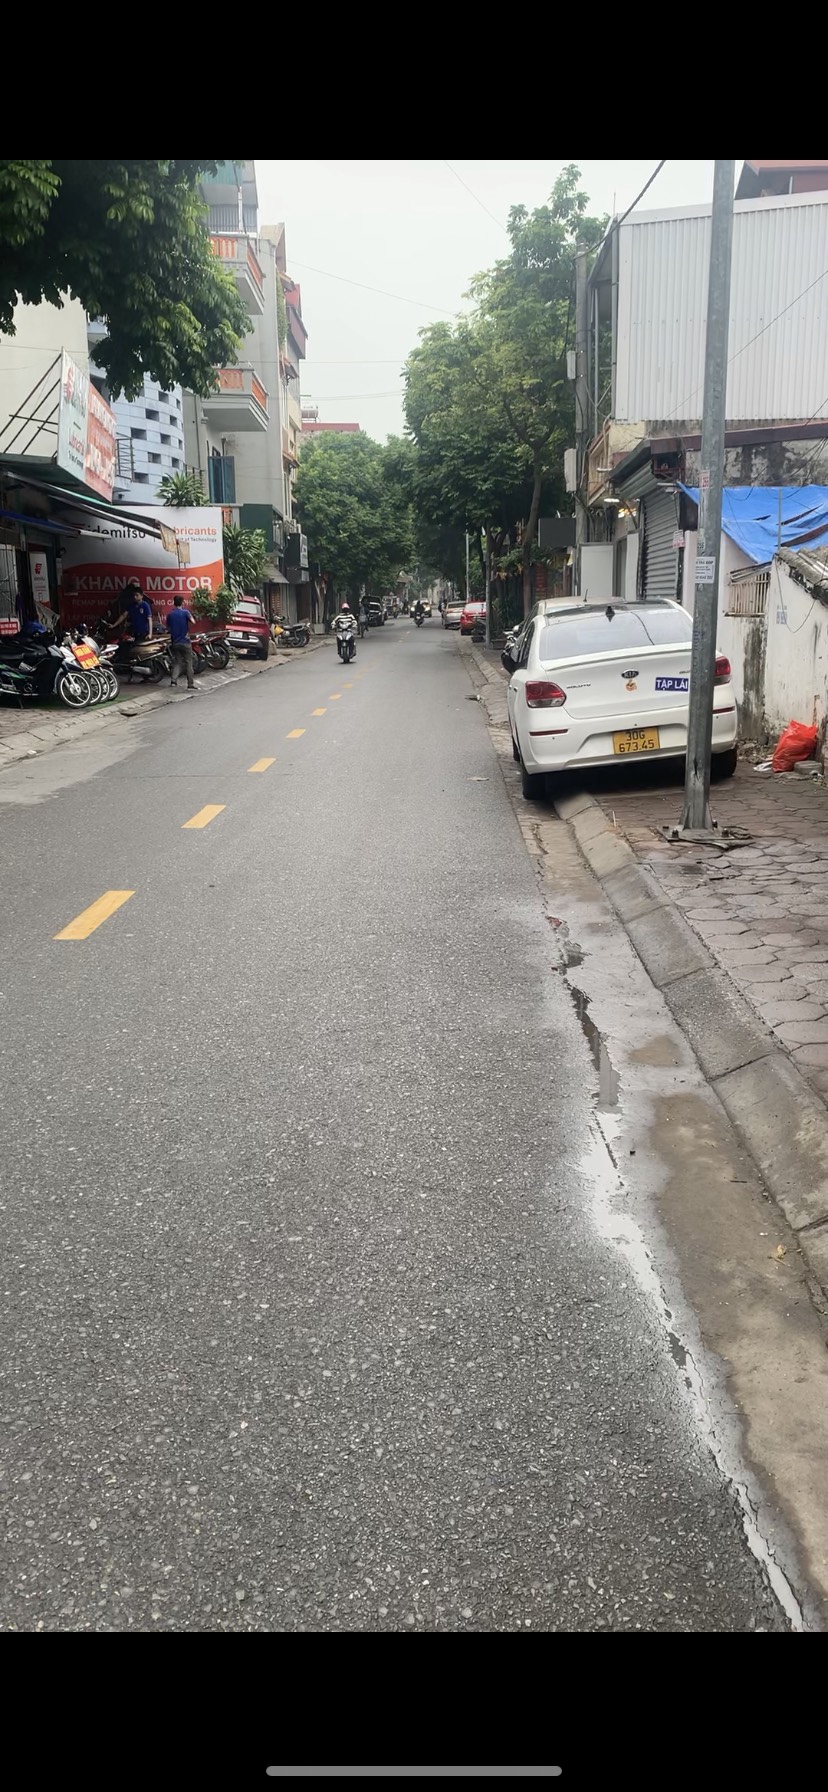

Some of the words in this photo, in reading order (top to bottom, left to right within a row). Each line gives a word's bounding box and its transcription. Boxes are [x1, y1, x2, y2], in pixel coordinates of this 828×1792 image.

[174, 525, 217, 536] bricants
[76, 576, 140, 591] KHANG
[146, 576, 212, 591] MOTOR
[674, 678, 688, 690] LÁI
[625, 730, 646, 742] 30G
[618, 739, 655, 753] 673.45
